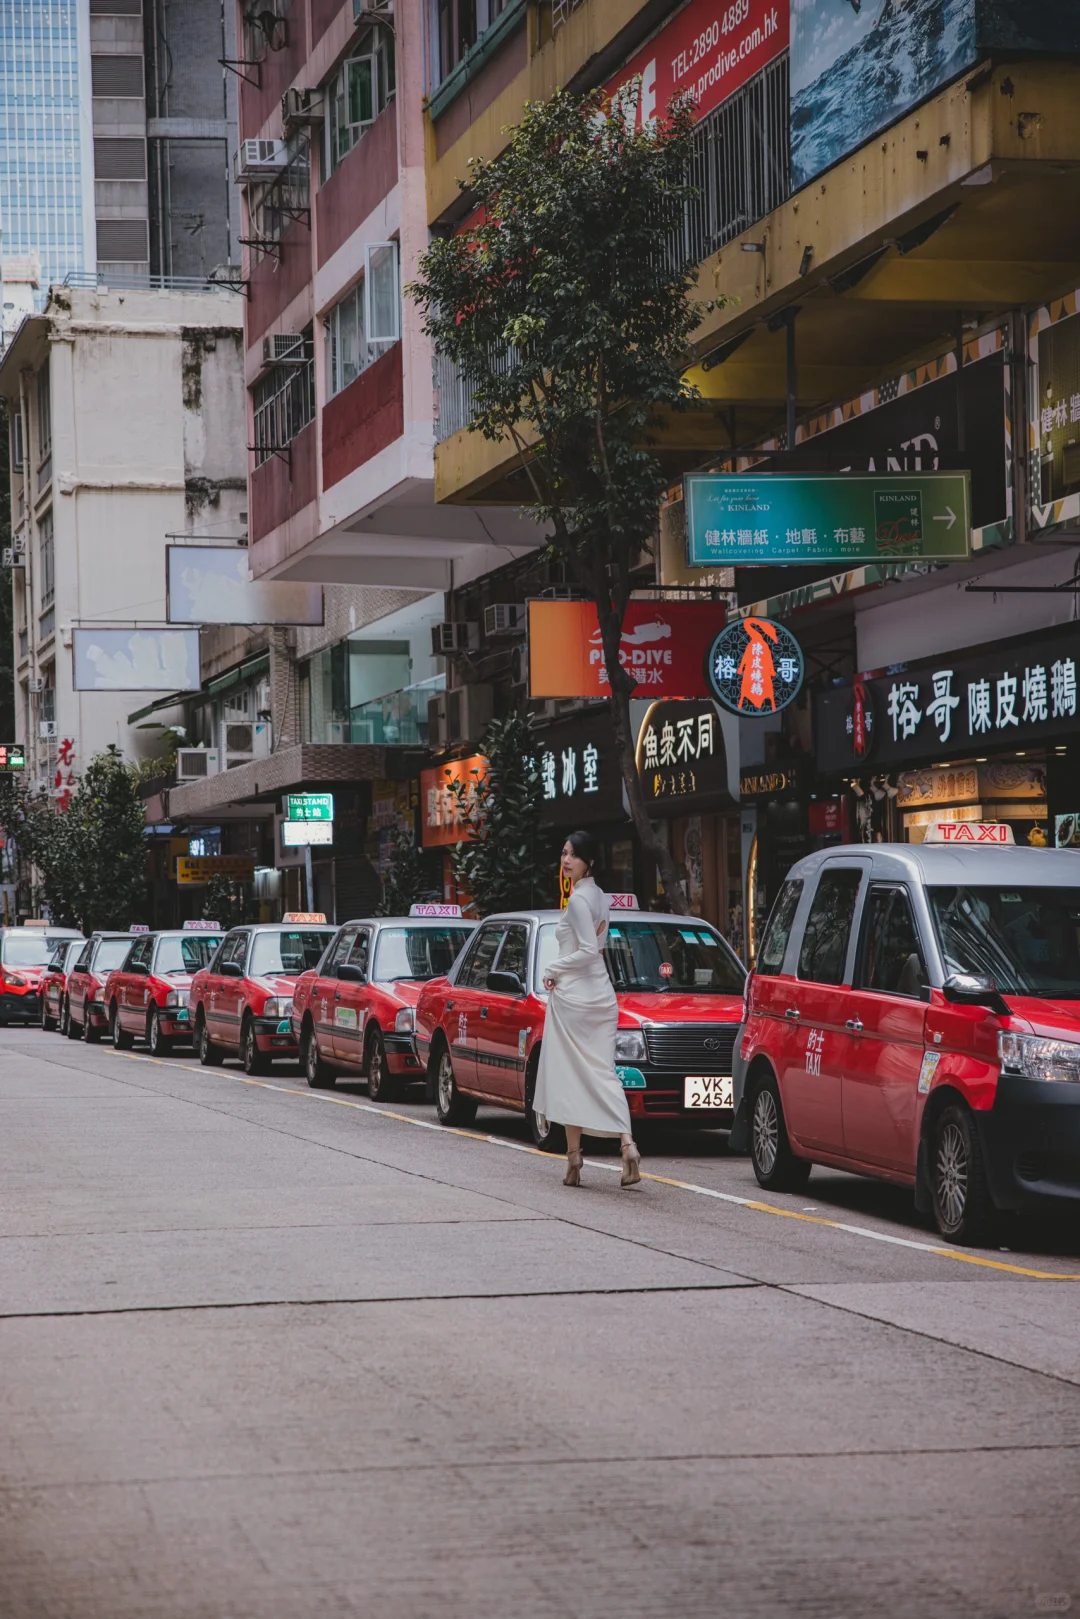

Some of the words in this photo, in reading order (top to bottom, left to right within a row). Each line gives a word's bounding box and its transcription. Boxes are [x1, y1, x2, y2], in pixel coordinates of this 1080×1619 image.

[671, 20, 719, 83] TEL:2890
[721, 0, 749, 37] 4889
[728, 504, 770, 512] KINLAND
[714, 655, 737, 680] 榕
[777, 658, 799, 683] 哥
[750, 642, 764, 696] 陳皮燒鵝
[887, 670, 960, 743] 榕哥
[968, 657, 1077, 736] 陳皮燒鵝
[303, 797, 328, 806] STAND
[937, 823, 1008, 841] TAXI
[610, 895, 633, 907] XI
[415, 905, 459, 916] TAXI
[187, 921, 218, 929] TAXI
[288, 913, 323, 923] TAXI
[660, 966, 672, 975] TAXI
[806, 1028, 825, 1053] 的士
[805, 1051, 822, 1077] TAXI
[618, 1070, 626, 1081] 4
[702, 1078, 723, 1092] VK
[691, 1093, 733, 1107] 2454
